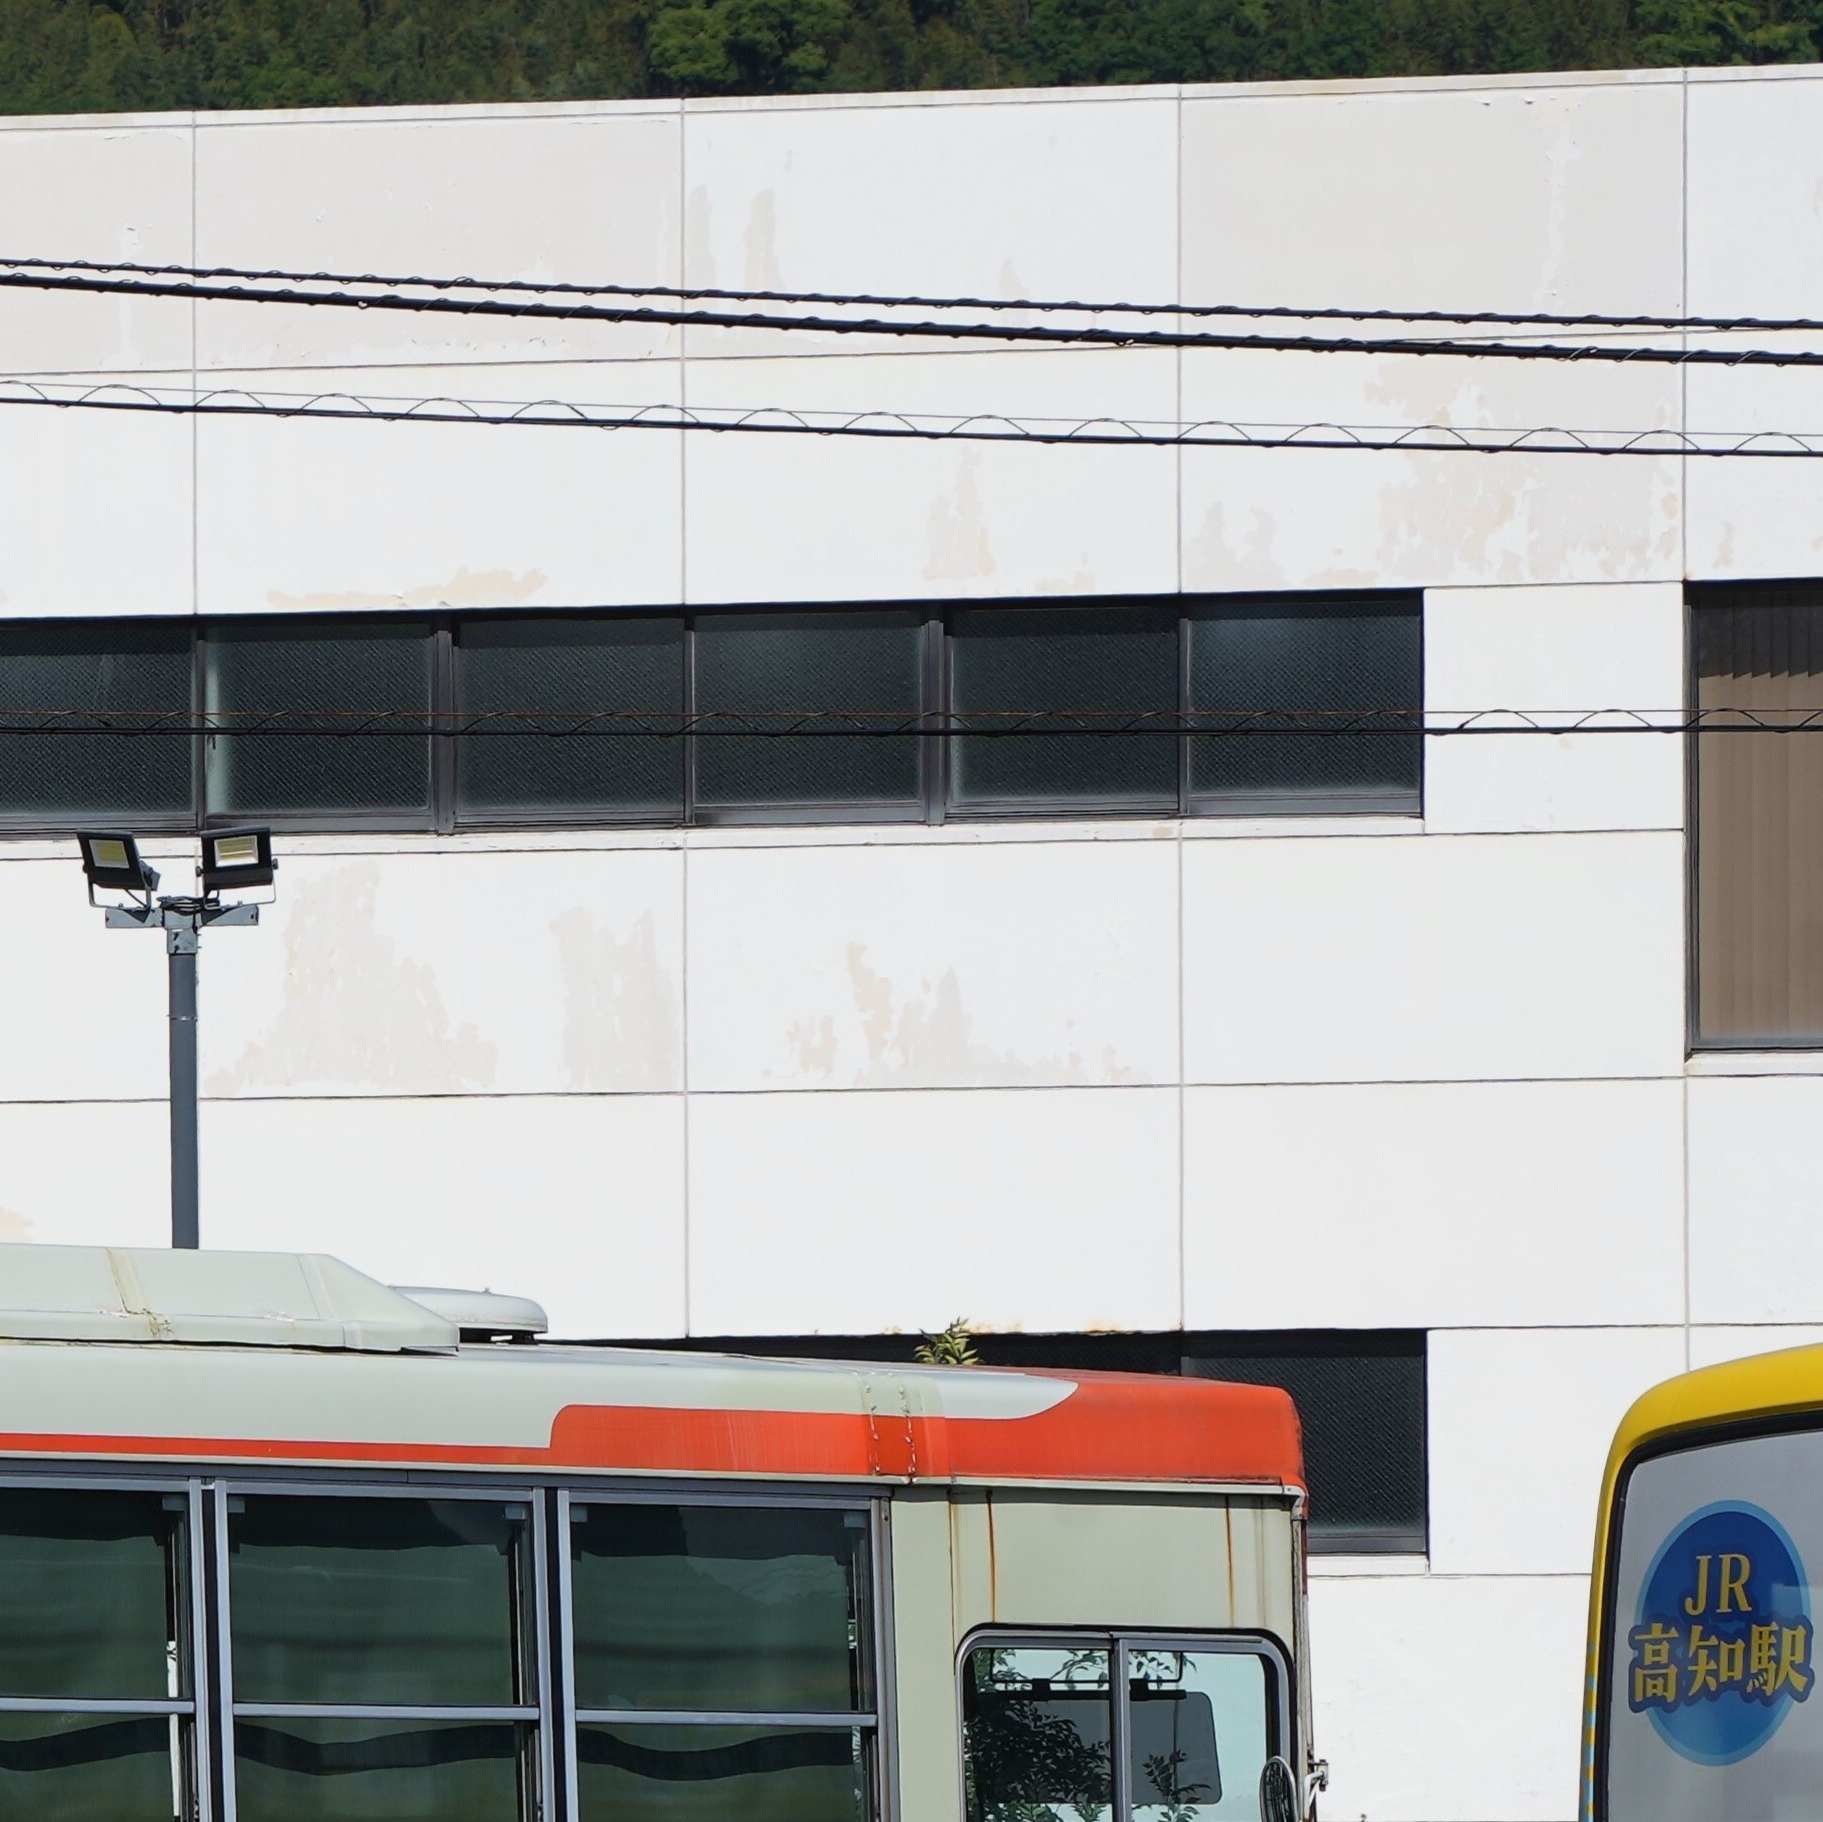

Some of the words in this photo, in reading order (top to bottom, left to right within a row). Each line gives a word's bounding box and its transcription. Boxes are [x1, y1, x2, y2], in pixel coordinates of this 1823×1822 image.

[1684, 1552, 1753, 1616] JR
[1633, 1621, 1810, 1703] 高知駅
